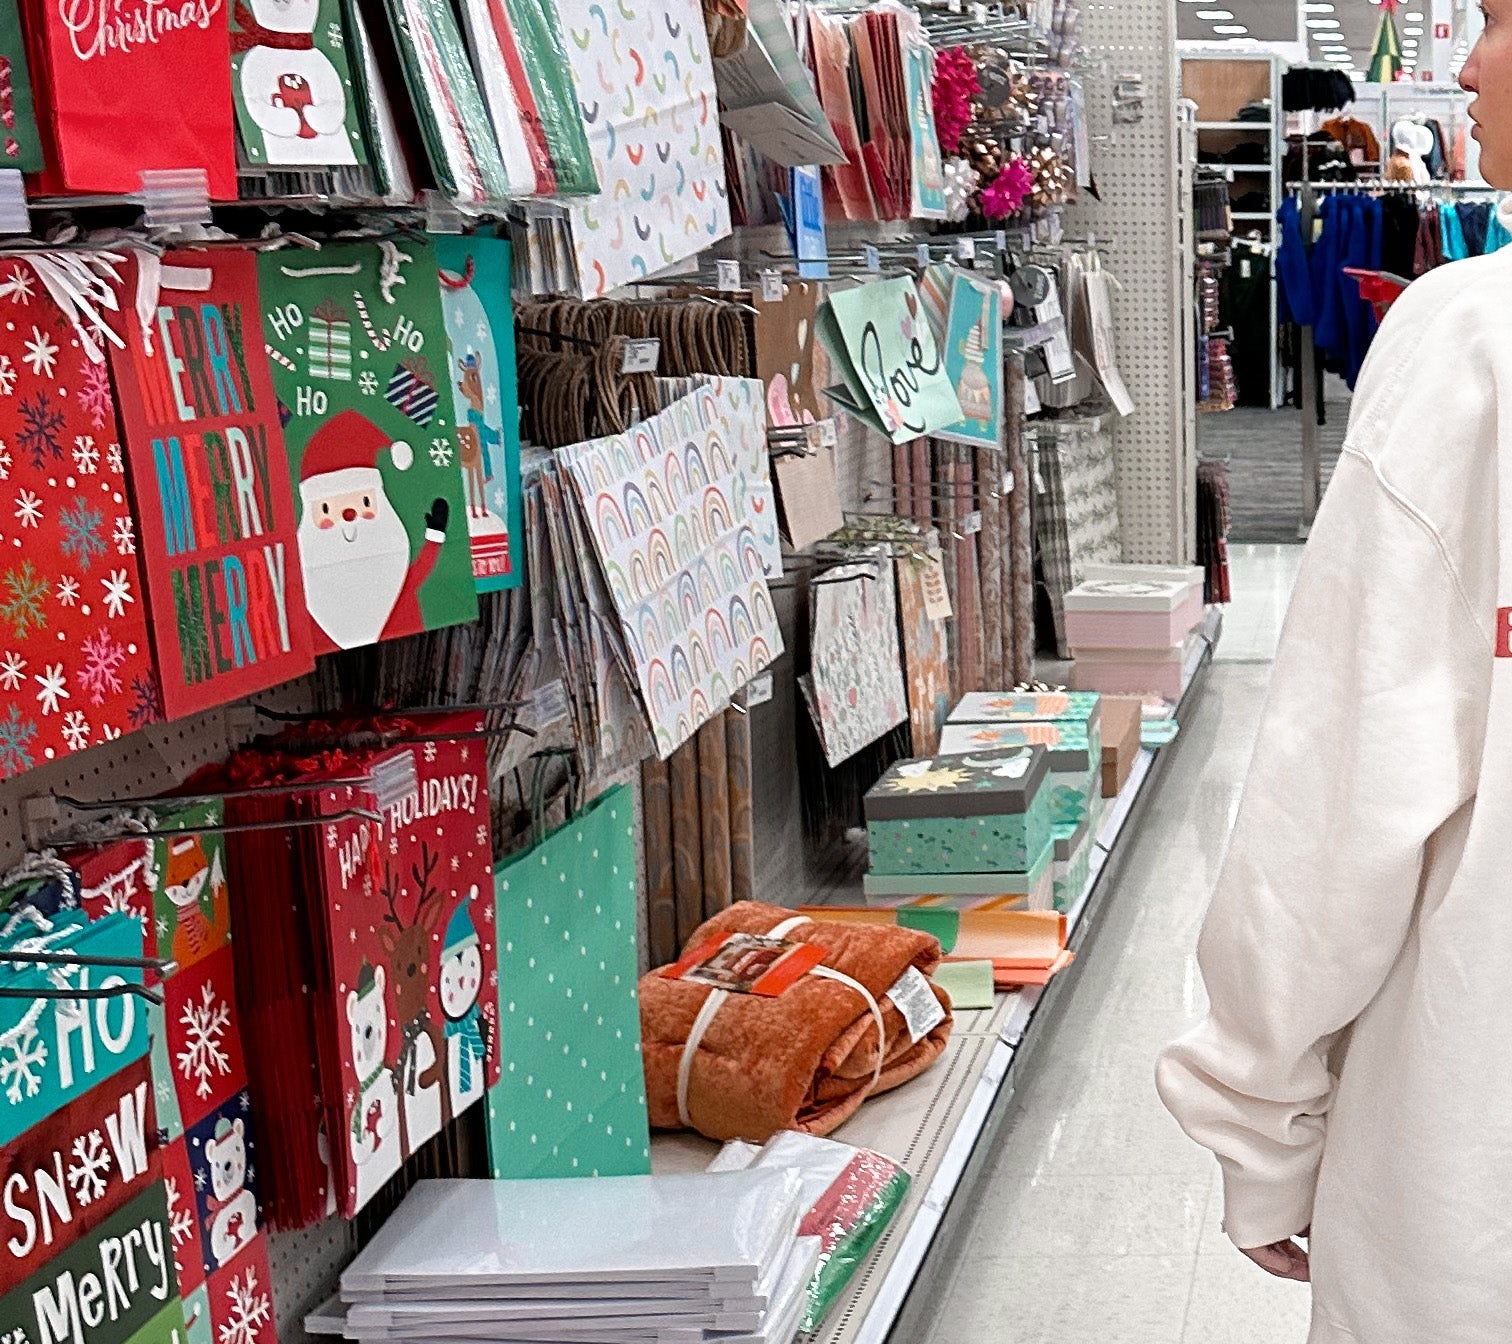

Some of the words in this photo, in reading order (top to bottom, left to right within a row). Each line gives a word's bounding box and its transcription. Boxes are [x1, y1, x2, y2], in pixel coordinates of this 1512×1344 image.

[268, 303, 304, 341] HO
[393, 316, 425, 352] HO
[125, 303, 255, 426] MERRY
[297, 387, 328, 416] HO
[153, 424, 275, 554] MERRY
[172, 543, 292, 686] MERRY
